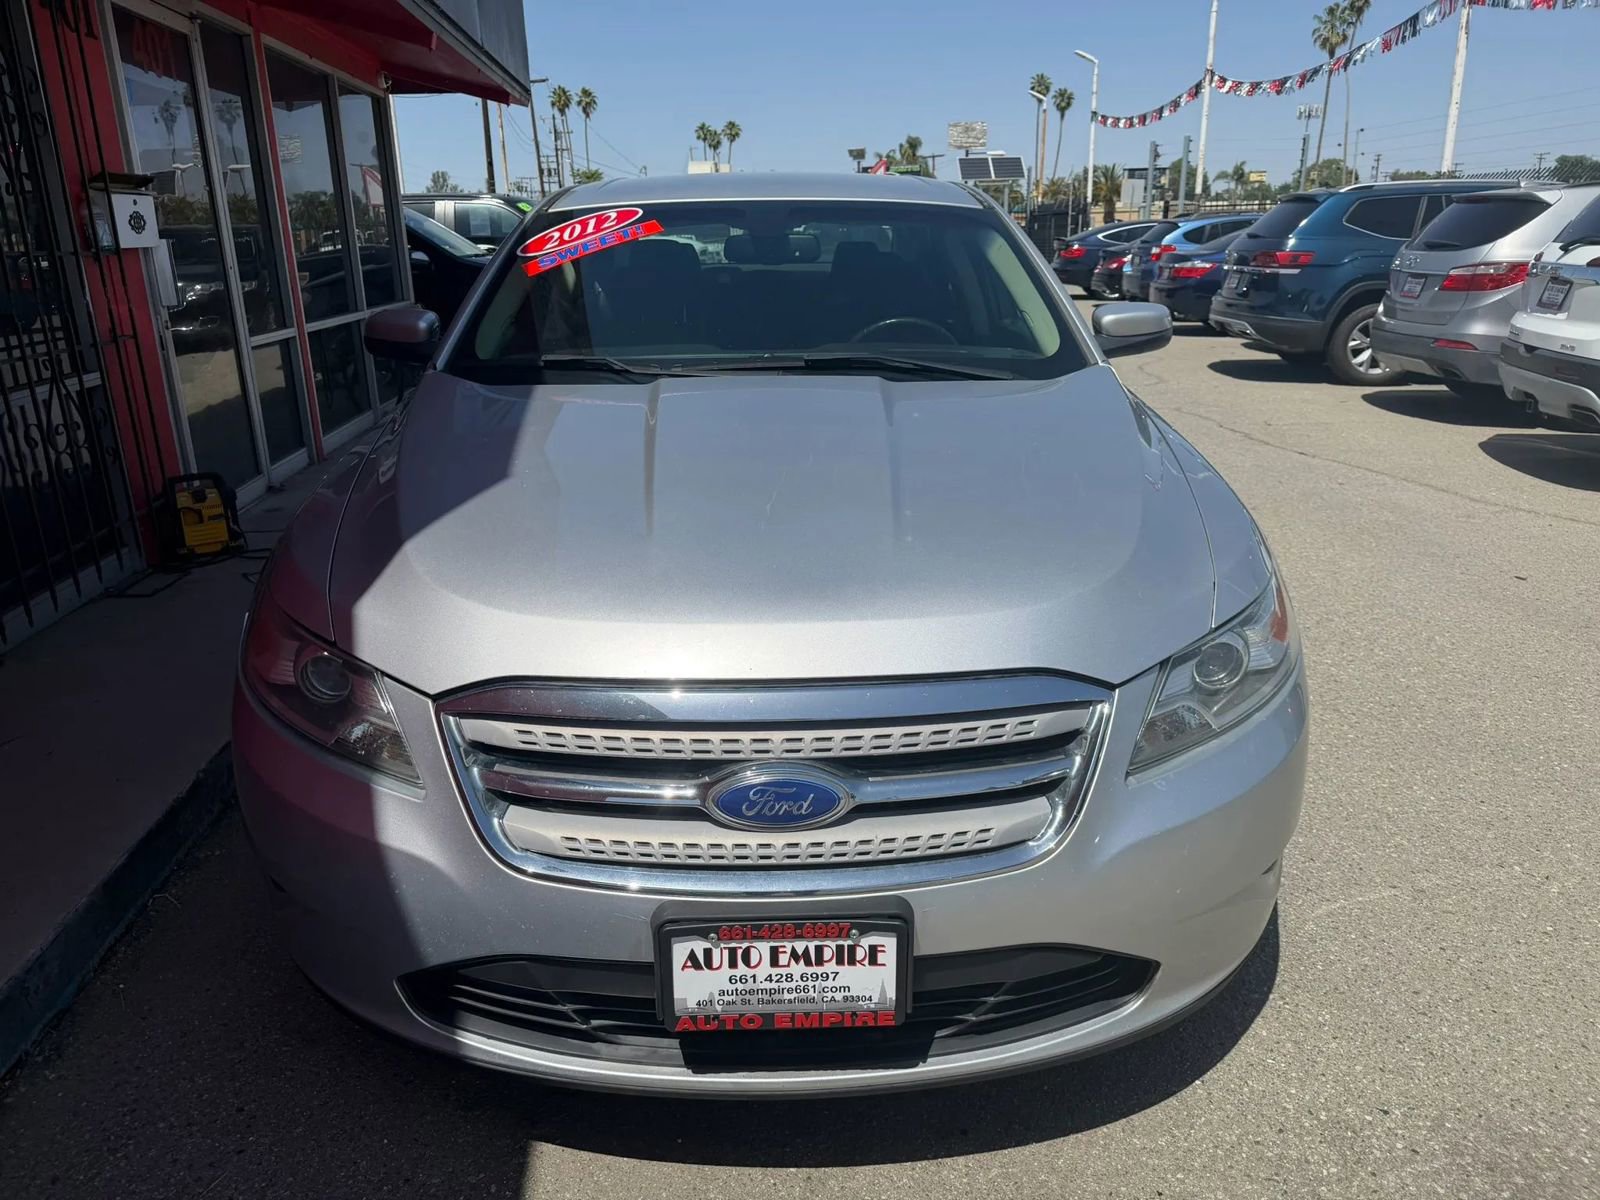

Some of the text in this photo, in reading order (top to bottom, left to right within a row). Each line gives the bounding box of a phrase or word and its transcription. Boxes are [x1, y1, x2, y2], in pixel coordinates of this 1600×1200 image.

[543, 211, 618, 250] 2012
[741, 786, 815, 816] Ford
[718, 923, 851, 941] 661-428-6997
[681, 943, 887, 971] AUTO EMPIRE
[728, 971, 840, 985] 661.428.6997
[695, 998, 714, 1007] 401
[716, 997, 738, 1007] Oak
[740, 997, 754, 1006] St.
[757, 995, 820, 1006] Bakersfield,
[842, 994, 873, 1004] 93304
[718, 984, 851, 998] autoempire661.com
[674, 1011, 896, 1032] AUTO EMPIRE
